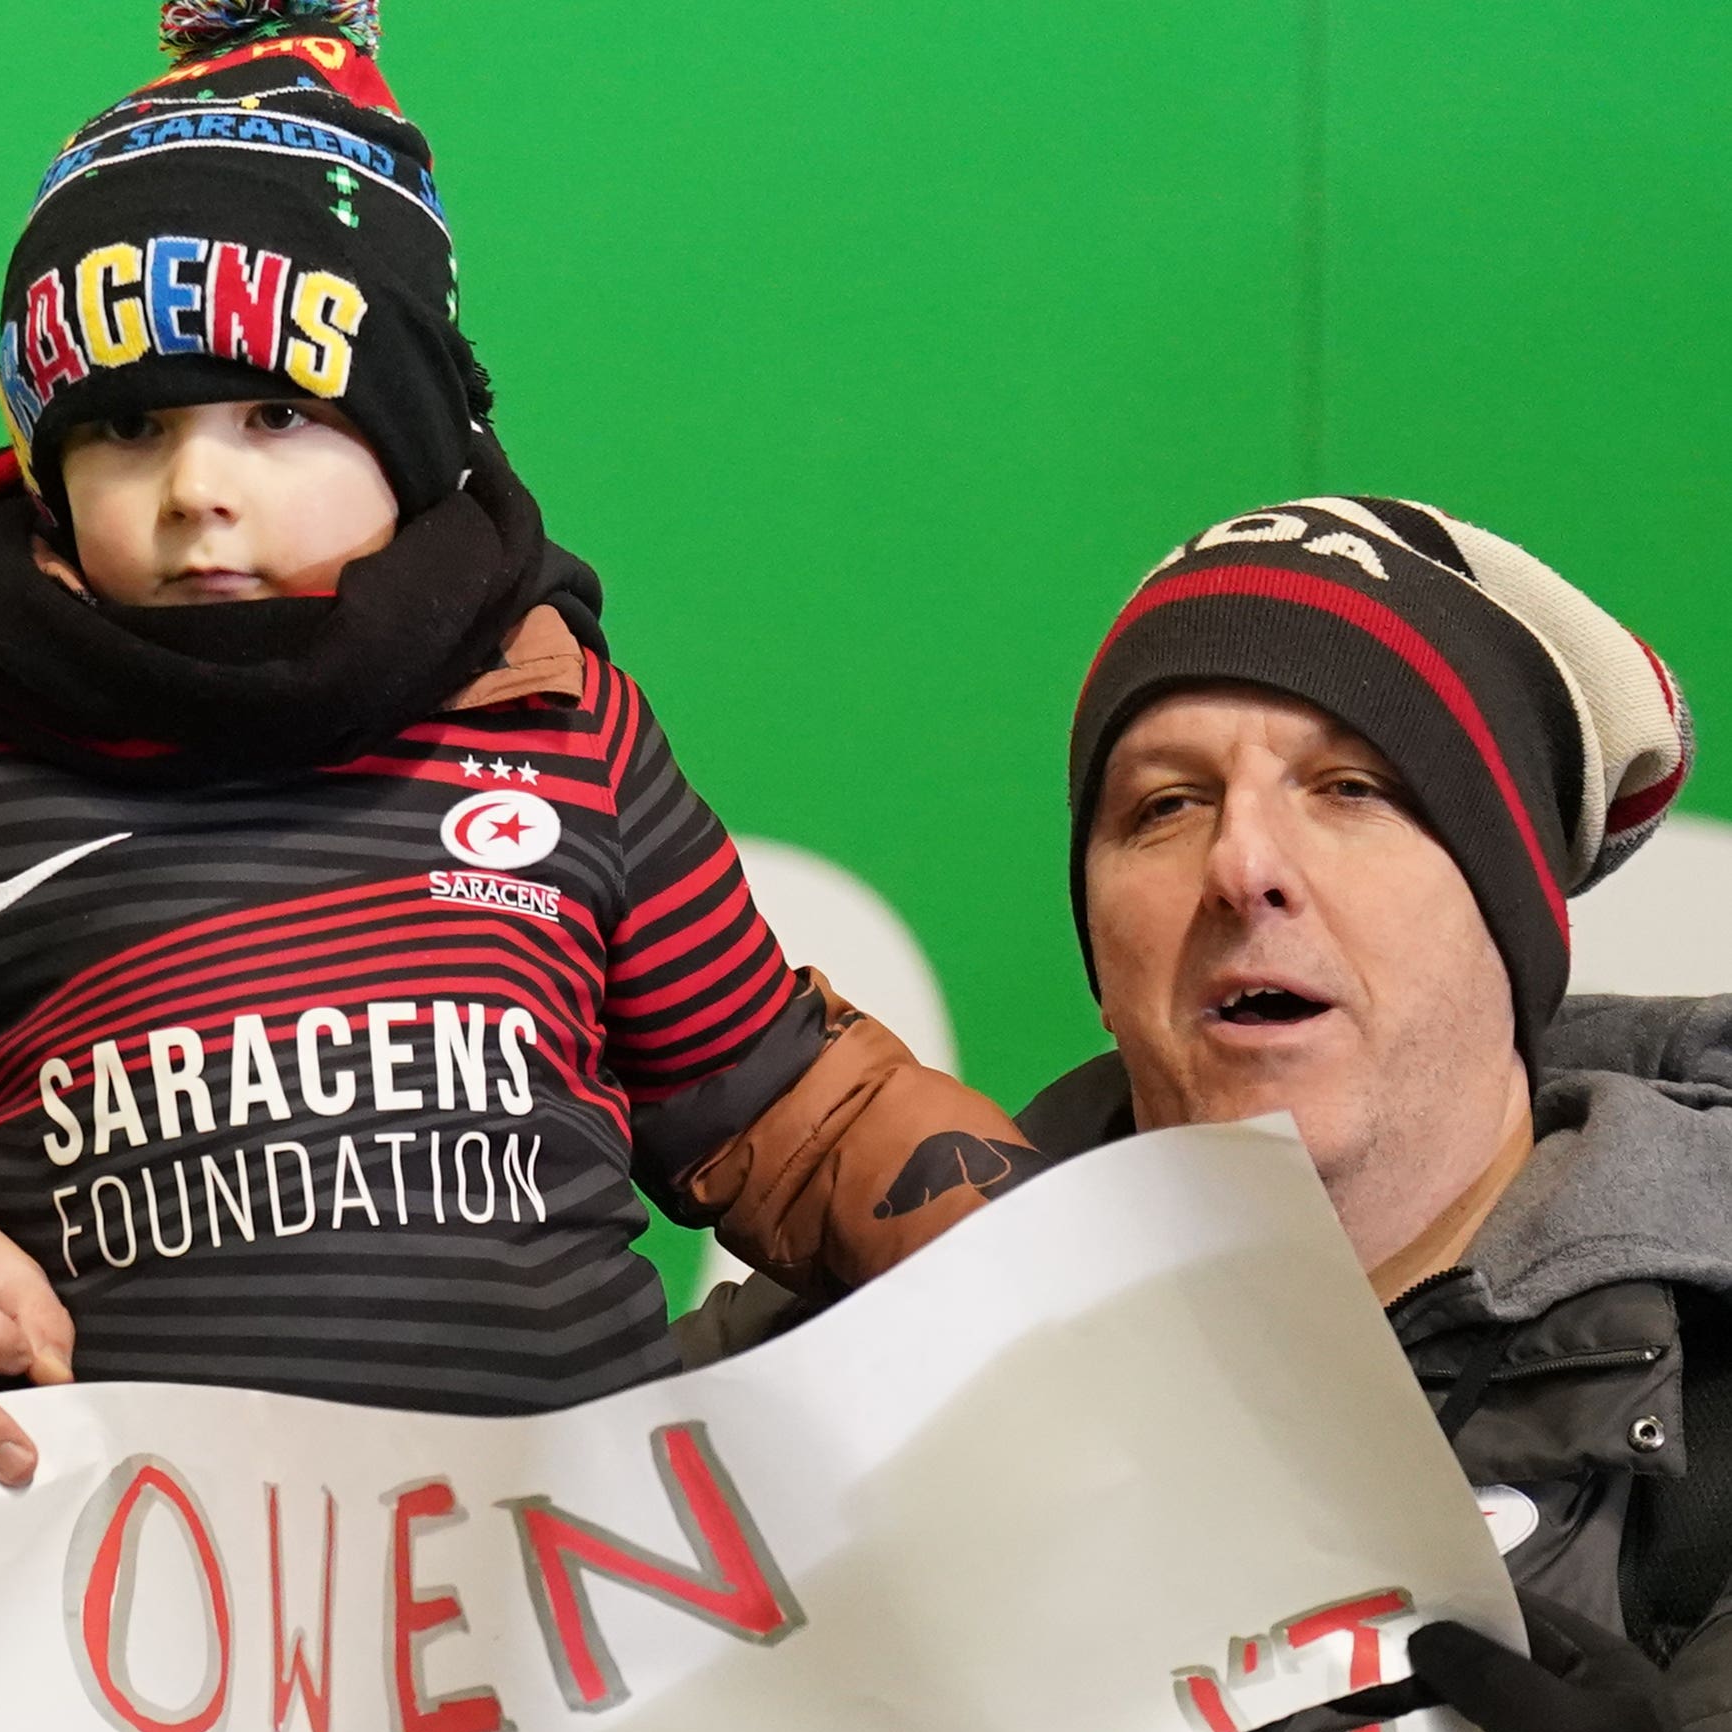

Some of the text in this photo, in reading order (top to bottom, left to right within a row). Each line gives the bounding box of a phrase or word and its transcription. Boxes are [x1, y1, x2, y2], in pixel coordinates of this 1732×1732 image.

[428, 870, 561, 916] SARACENS
[38, 1001, 537, 1166] SARACENS
[51, 1131, 547, 1278] FOUNDATION
